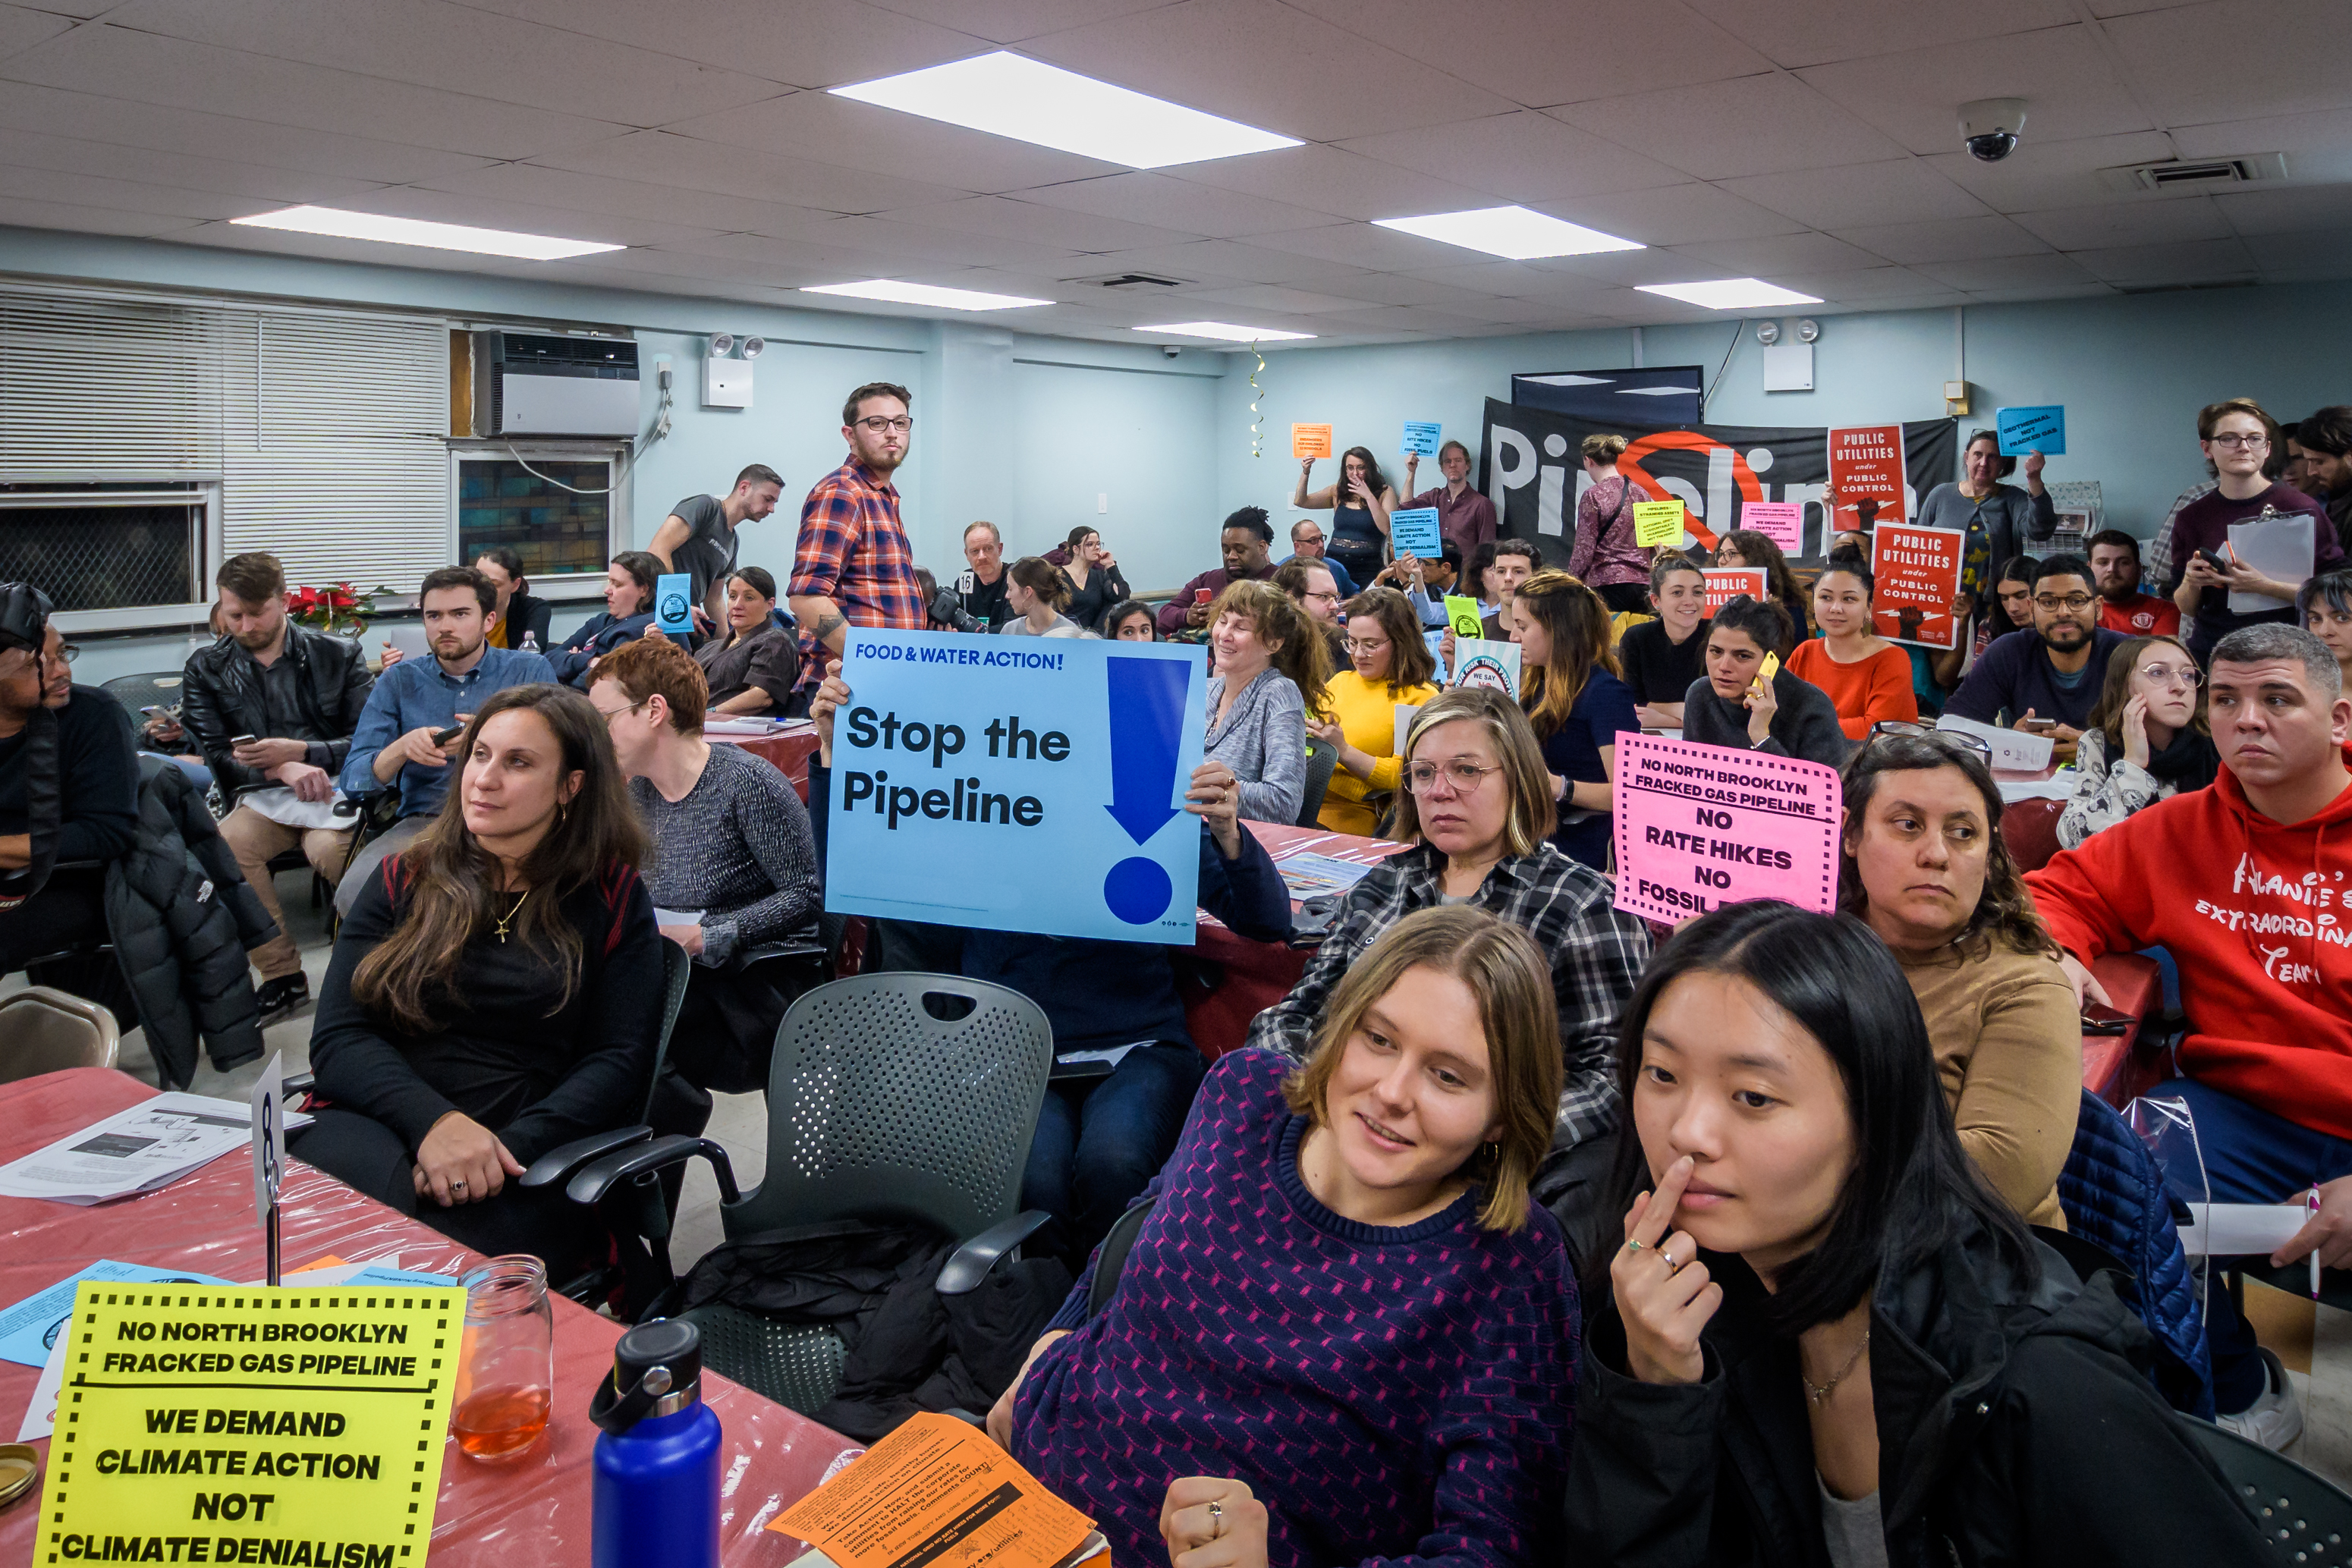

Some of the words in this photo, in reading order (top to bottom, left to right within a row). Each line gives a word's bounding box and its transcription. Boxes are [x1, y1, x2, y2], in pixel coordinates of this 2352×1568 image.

[2004, 414, 2051, 434] GEOTHERMAL
[2020, 427, 2036, 435] NOT
[1844, 432, 1885, 445] PUBLIC
[2009, 433, 2040, 448] FRACKED
[2042, 428, 2058, 436] GAS
[1837, 447, 1894, 460] UTILITIES
[1841, 484, 1894, 493] CONTROL
[1847, 474, 1888, 482] PUBLIC
[1893, 534, 1942, 551] PUBLIC
[1882, 549, 1950, 569] UTILITIES
[961, 575, 971, 589] 16
[1705, 578, 1747, 590] PUBLIC
[1890, 579, 1938, 592] PUBLIC
[1902, 569, 1927, 577] under
[1883, 589, 1944, 604] CONTROL
[855, 643, 903, 661] FOOD
[905, 646, 917, 661] &
[920, 647, 980, 665] WATER
[983, 652, 1064, 670] ACTION!
[1464, 659, 1479, 674] RISK
[1481, 658, 1499, 671] THEIR
[846, 705, 966, 768] Stop
[983, 715, 1071, 762] the
[1640, 758, 1662, 771] NO
[1663, 761, 1715, 781] NORTH
[1717, 771, 1807, 796] BROOKLYN
[844, 770, 1043, 830] Pipeline
[1635, 775, 1702, 796] FRACKED
[1705, 787, 1737, 803] GAS
[1740, 793, 1816, 815] PIPELINE
[1696, 807, 1733, 830] NO
[1646, 825, 1706, 855] RATE
[1709, 840, 1792, 870] HIKES
[1694, 866, 1731, 889] NO
[1639, 878, 1706, 914] FOSSIL
[263, 1092, 273, 1181] 8
[118, 1321, 157, 1341] NO
[162, 1323, 257, 1343] NORTH
[263, 1324, 407, 1344] BROOKLYN
[103, 1353, 236, 1374] FRACKED
[240, 1354, 294, 1375] GAS
[299, 1356, 416, 1377] PIPELINE
[145, 1409, 198, 1434] WE
[203, 1411, 345, 1438] DEMAND
[96, 1450, 246, 1475] CLIMATE
[251, 1453, 380, 1481] ACTION
[821, 1520, 835, 1530] We
[836, 1494, 868, 1519] deserve
[869, 1480, 890, 1494] safe,
[890, 1456, 919, 1479] healthy
[919, 1437, 948, 1456] homes.
[826, 1523, 840, 1532] We
[841, 1497, 873, 1522] demand
[875, 1478, 901, 1497] action
[901, 1469, 911, 1478] on
[913, 1447, 943, 1469] climate.
[192, 1493, 275, 1521] NOT
[837, 1529, 857, 1544] Take
[859, 1510, 884, 1529] Action
[884, 1495, 904, 1510] Now,
[904, 1484, 919, 1496] and
[920, 1466, 945, 1485] submit
[844, 1522, 880, 1548] comment
[890, 1499, 910, 1515] HALT
[912, 1489, 925, 1500] the
[926, 1463, 961, 1491] corporate
[849, 1530, 879, 1553] utilities
[879, 1516, 898, 1532] from
[899, 1497, 926, 1518] raising
[926, 1489, 939, 1497] our
[939, 1474, 958, 1488] rates
[959, 1465, 970, 1475] for
[854, 1542, 875, 1558] more
[876, 1524, 901, 1543] fossil
[901, 1513, 920, 1526] fuels.
[920, 1482, 960, 1511] Comments
[895, 1541, 907, 1551] NEW
[907, 1530, 922, 1541] YORK
[935, 1513, 946, 1522] AND
[948, 1503, 961, 1513] LONG
[961, 1489, 979, 1504] ISLAND
[900, 1551, 923, 1568] NATIONAL
[923, 1543, 935, 1552] GRID
[942, 1529, 953, 1539] RATE
[953, 1519, 967, 1530] HIKES
[966, 1513, 976, 1521] FOR
[975, 1504, 989, 1516] MORE
[944, 1532, 959, 1544] FUELS
[967, 1529, 1023, 1568] y.org/utilities
[61, 1535, 212, 1563] CLIMATE
[215, 1538, 395, 1568] DENIALISM
